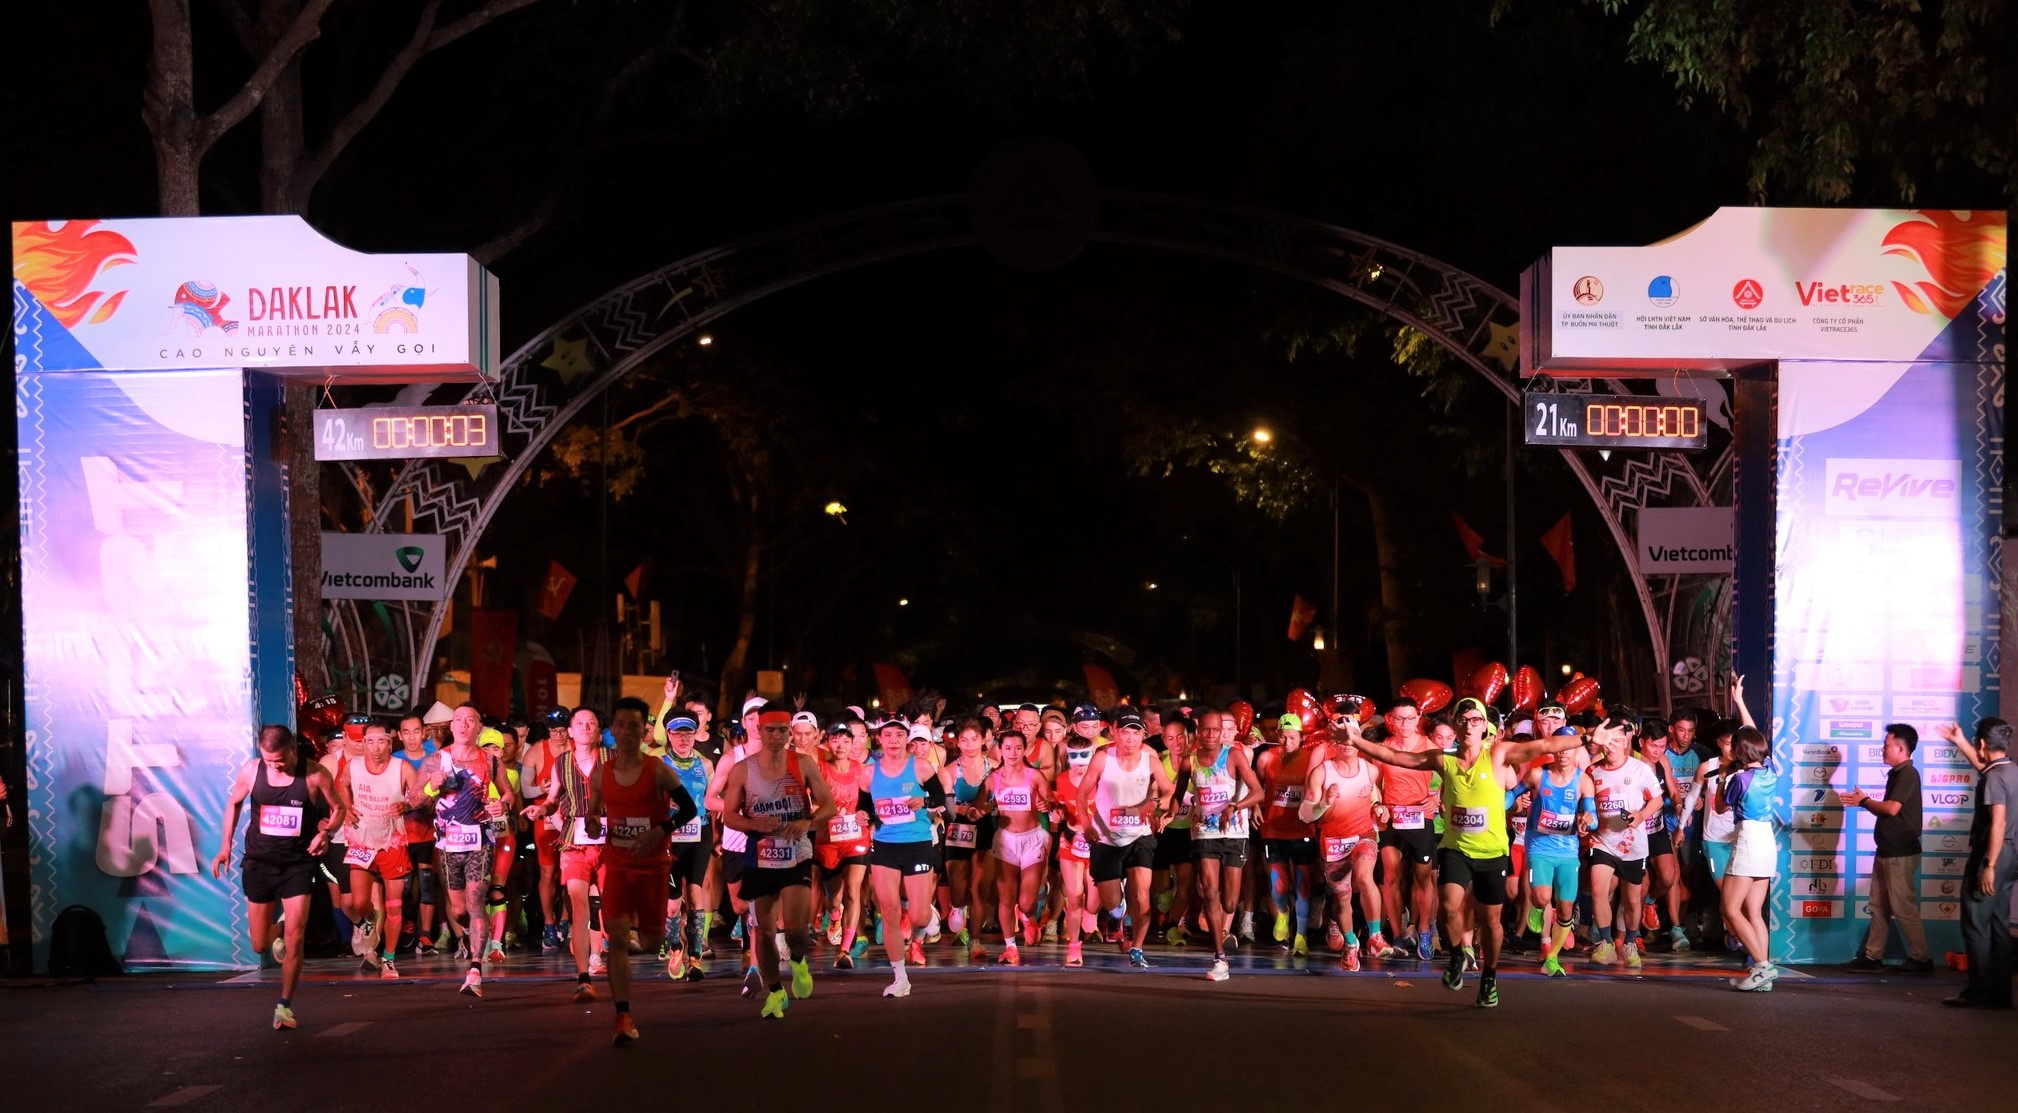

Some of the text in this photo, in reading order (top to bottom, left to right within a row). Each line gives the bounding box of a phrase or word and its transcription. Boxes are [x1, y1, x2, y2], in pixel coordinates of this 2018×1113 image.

[249, 285, 358, 321] DAKLAK
[1852, 294, 1874, 304] 365
[248, 323, 360, 337] MARATHON 2024
[160, 348, 202, 359] CAO
[225, 343, 314, 358] NGUYÊN
[397, 343, 435, 357] GỌI
[1587, 404, 1699, 437] 00:00:00
[373, 415, 486, 448] 00:00:03
[1934, 749, 1958, 758] BIDV
[358, 783, 372, 793] AIA
[1200, 792, 1228, 804] 42222
[1274, 791, 1300, 799] PACER
[1931, 794, 1969, 805] VLOOP
[1600, 800, 1624, 810] 42260
[262, 813, 297, 827] 42081
[1111, 815, 1140, 824] 42305
[1453, 815, 1484, 825] 42304
[1541, 817, 1569, 829] 42514
[448, 833, 476, 843] 42201
[947, 830, 972, 840] 4279
[760, 848, 791, 859] 42331
